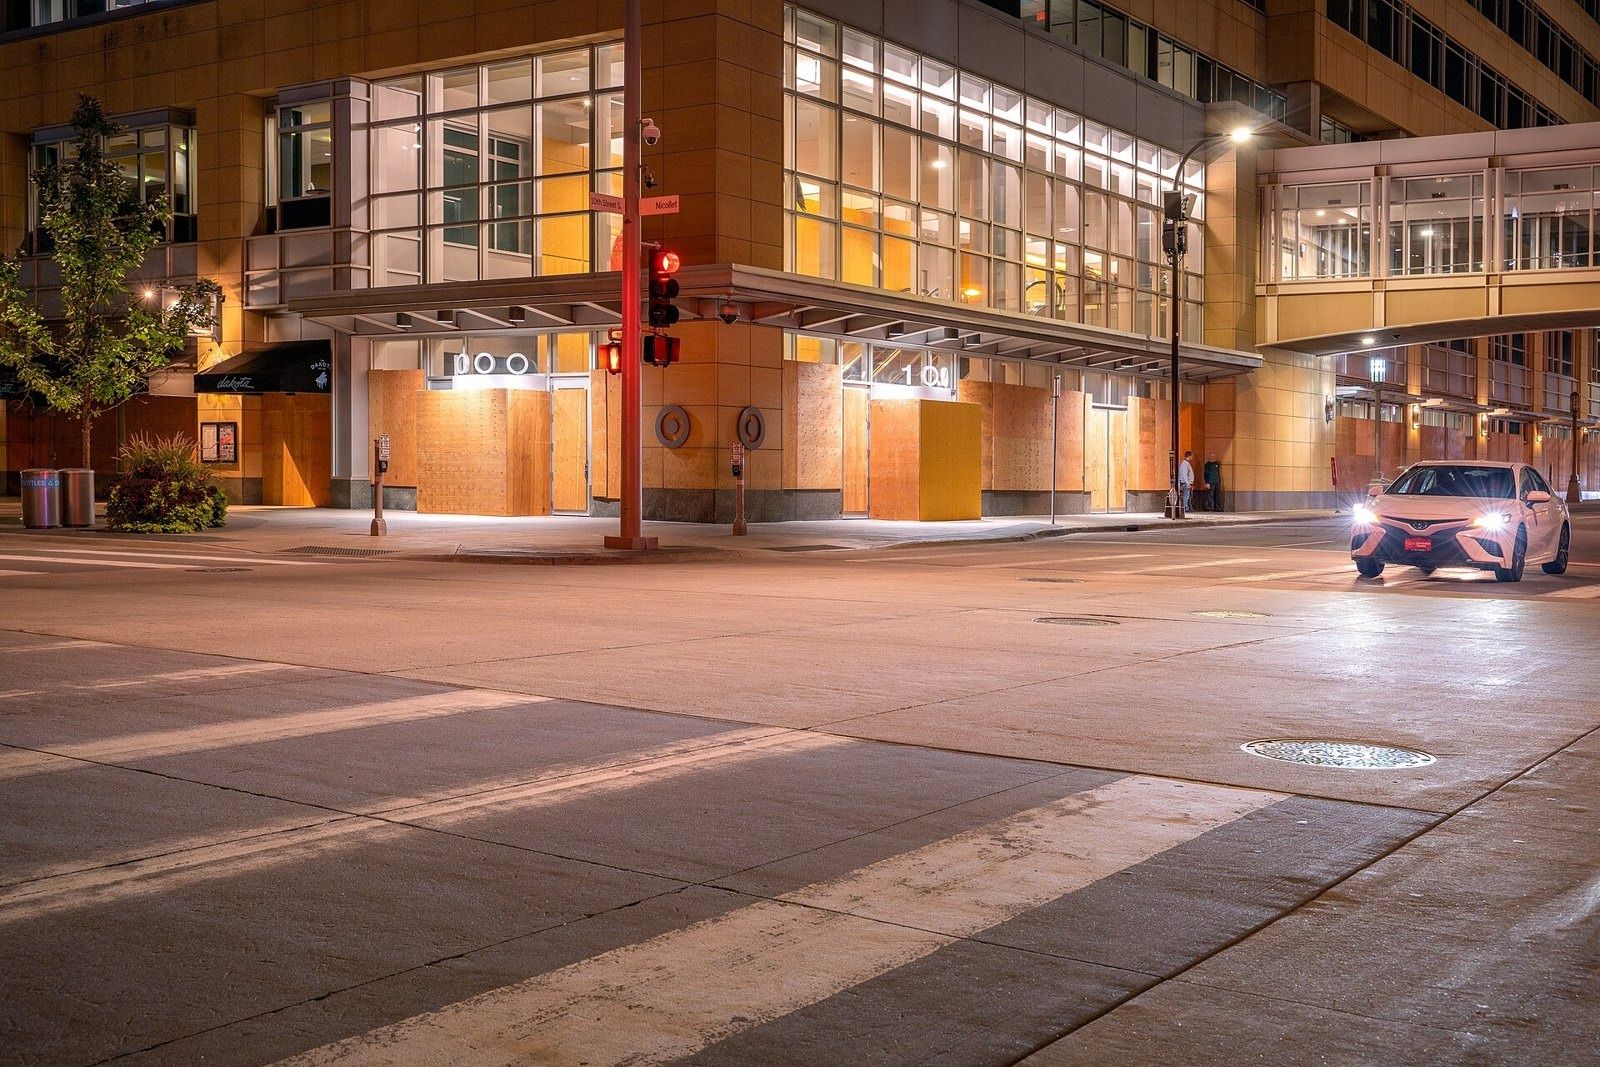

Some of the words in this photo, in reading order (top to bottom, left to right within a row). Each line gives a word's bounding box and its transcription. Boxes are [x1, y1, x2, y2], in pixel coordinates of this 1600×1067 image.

[655, 200, 678, 210] Nicollet
[310, 361, 332, 370] DAKOT
[216, 375, 255, 392] dakota
